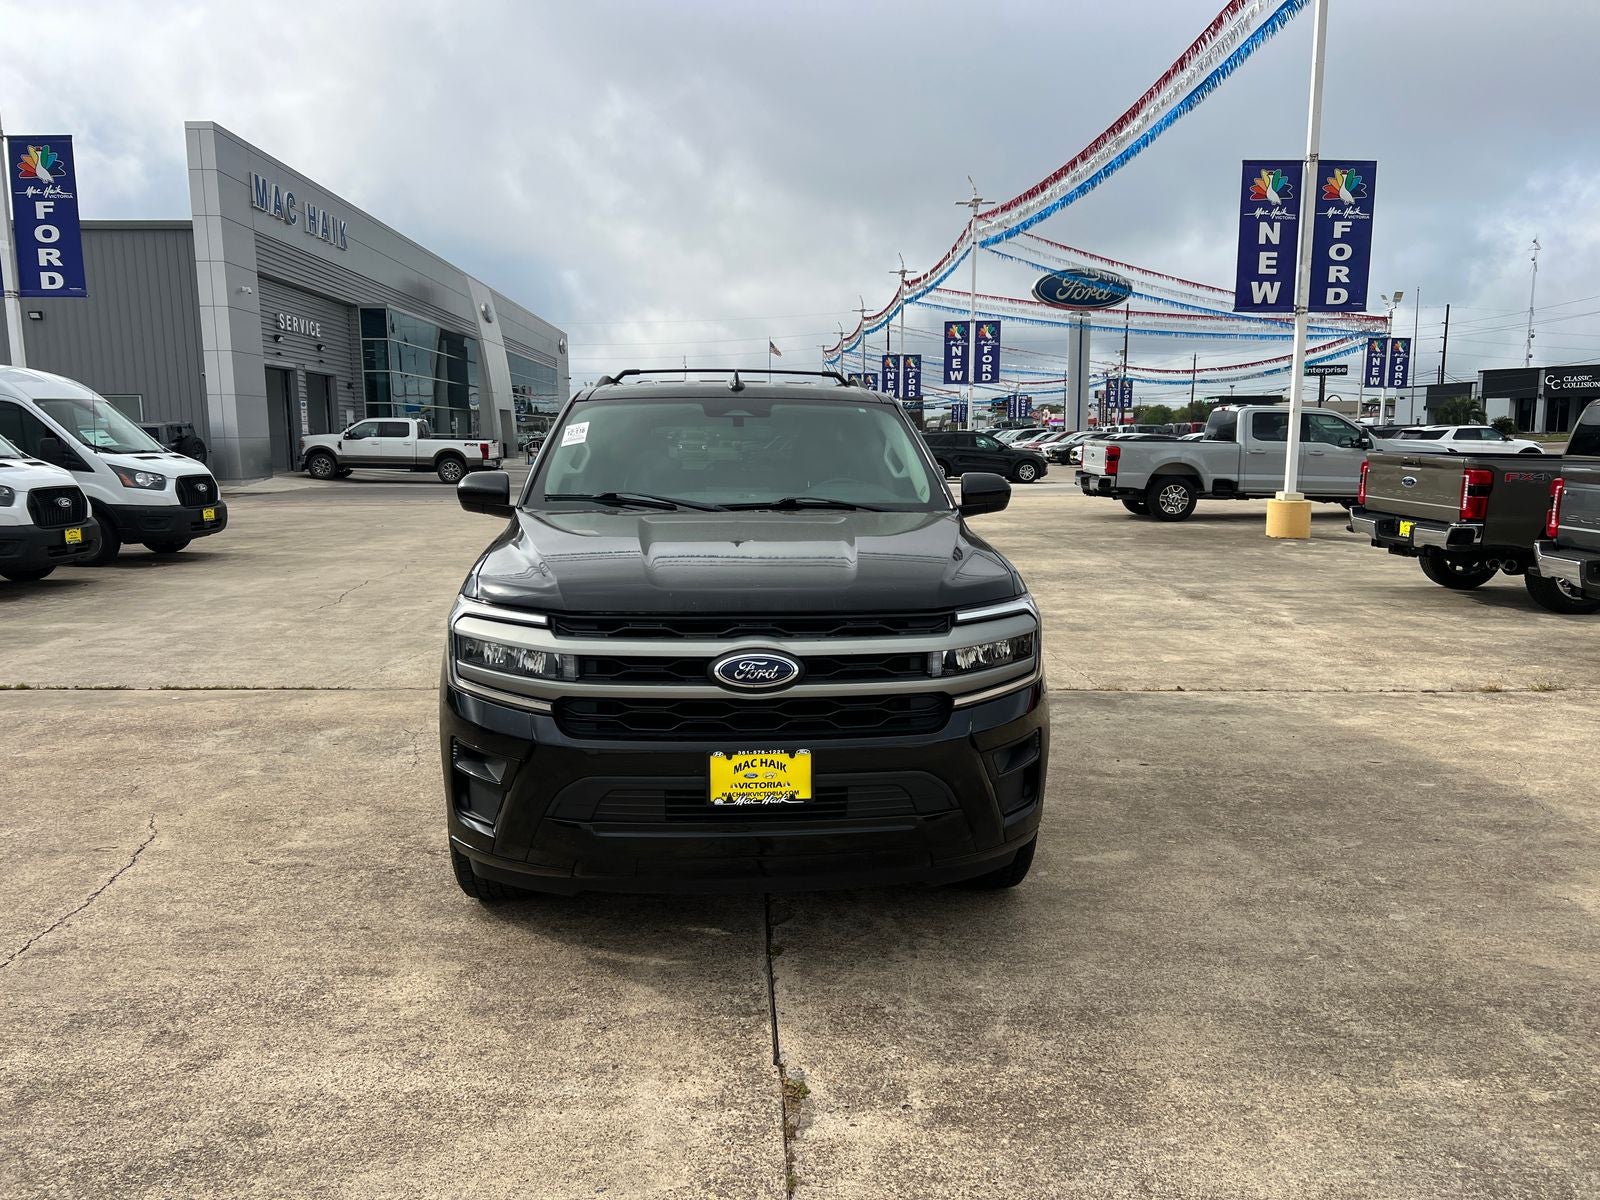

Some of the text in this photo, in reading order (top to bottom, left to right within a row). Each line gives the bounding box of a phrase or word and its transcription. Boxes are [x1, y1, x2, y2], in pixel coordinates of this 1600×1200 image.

[25, 185, 65, 198] Mac Haik
[250, 171, 348, 251] MAC HAIK
[1254, 206, 1288, 219] Mac Haik
[1327, 206, 1362, 219] Mac Haik
[34, 201, 64, 290] FORD
[1251, 222, 1281, 304] NEW
[1326, 221, 1352, 305] FORD
[1056, 271, 1113, 301] Ford
[279, 313, 321, 337] SERVICE
[949, 346, 963, 381] NEW
[981, 346, 993, 381] FORD
[1369, 357, 1380, 386] NEW
[1394, 357, 1404, 386] FORD
[886, 372, 895, 397] NEW
[908, 372, 916, 397] FORD
[1505, 472, 1545, 482] FX4
[734, 661, 779, 680] Ford
[733, 758, 787, 774] MAC HAIK
[738, 781, 783, 789] VICTORIA
[734, 793, 789, 805] Mac Haik
